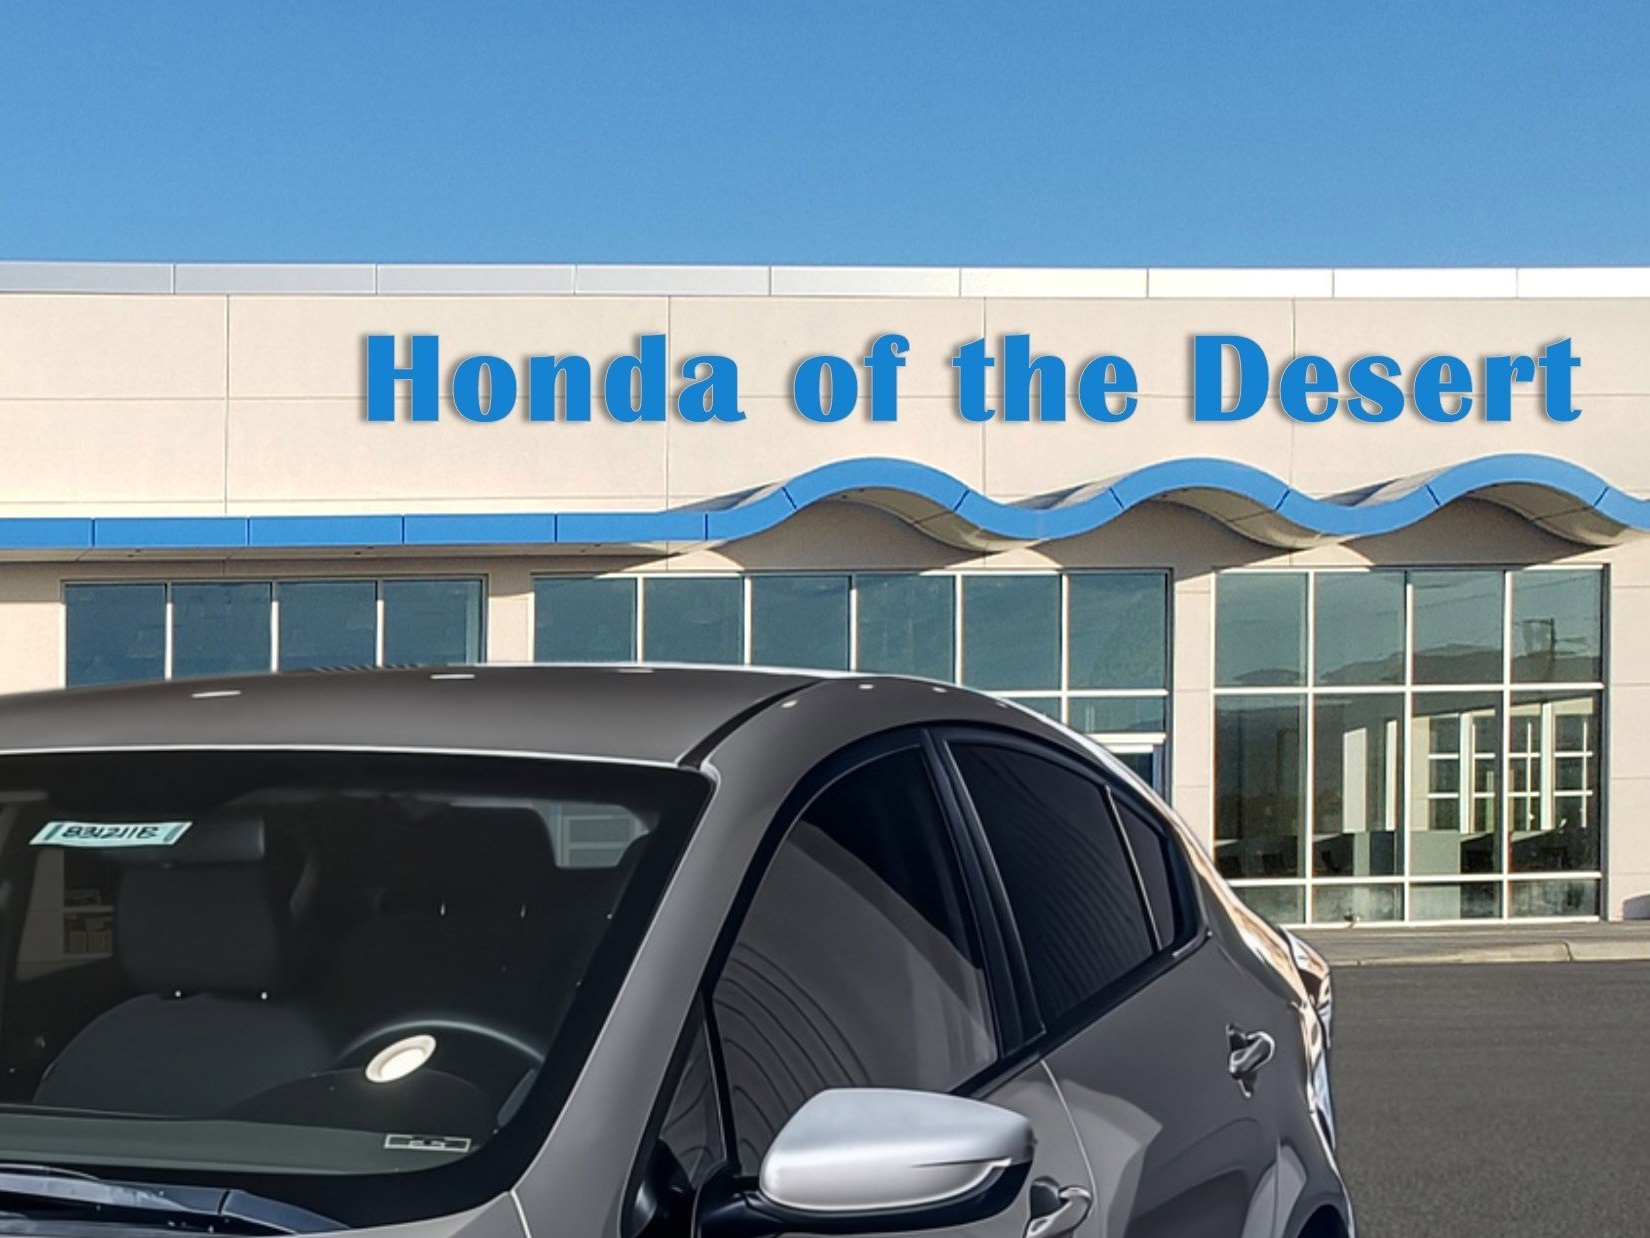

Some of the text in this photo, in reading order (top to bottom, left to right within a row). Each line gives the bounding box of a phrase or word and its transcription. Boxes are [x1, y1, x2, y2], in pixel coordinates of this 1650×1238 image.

[366, 333, 1582, 424] Honda of the Desert
